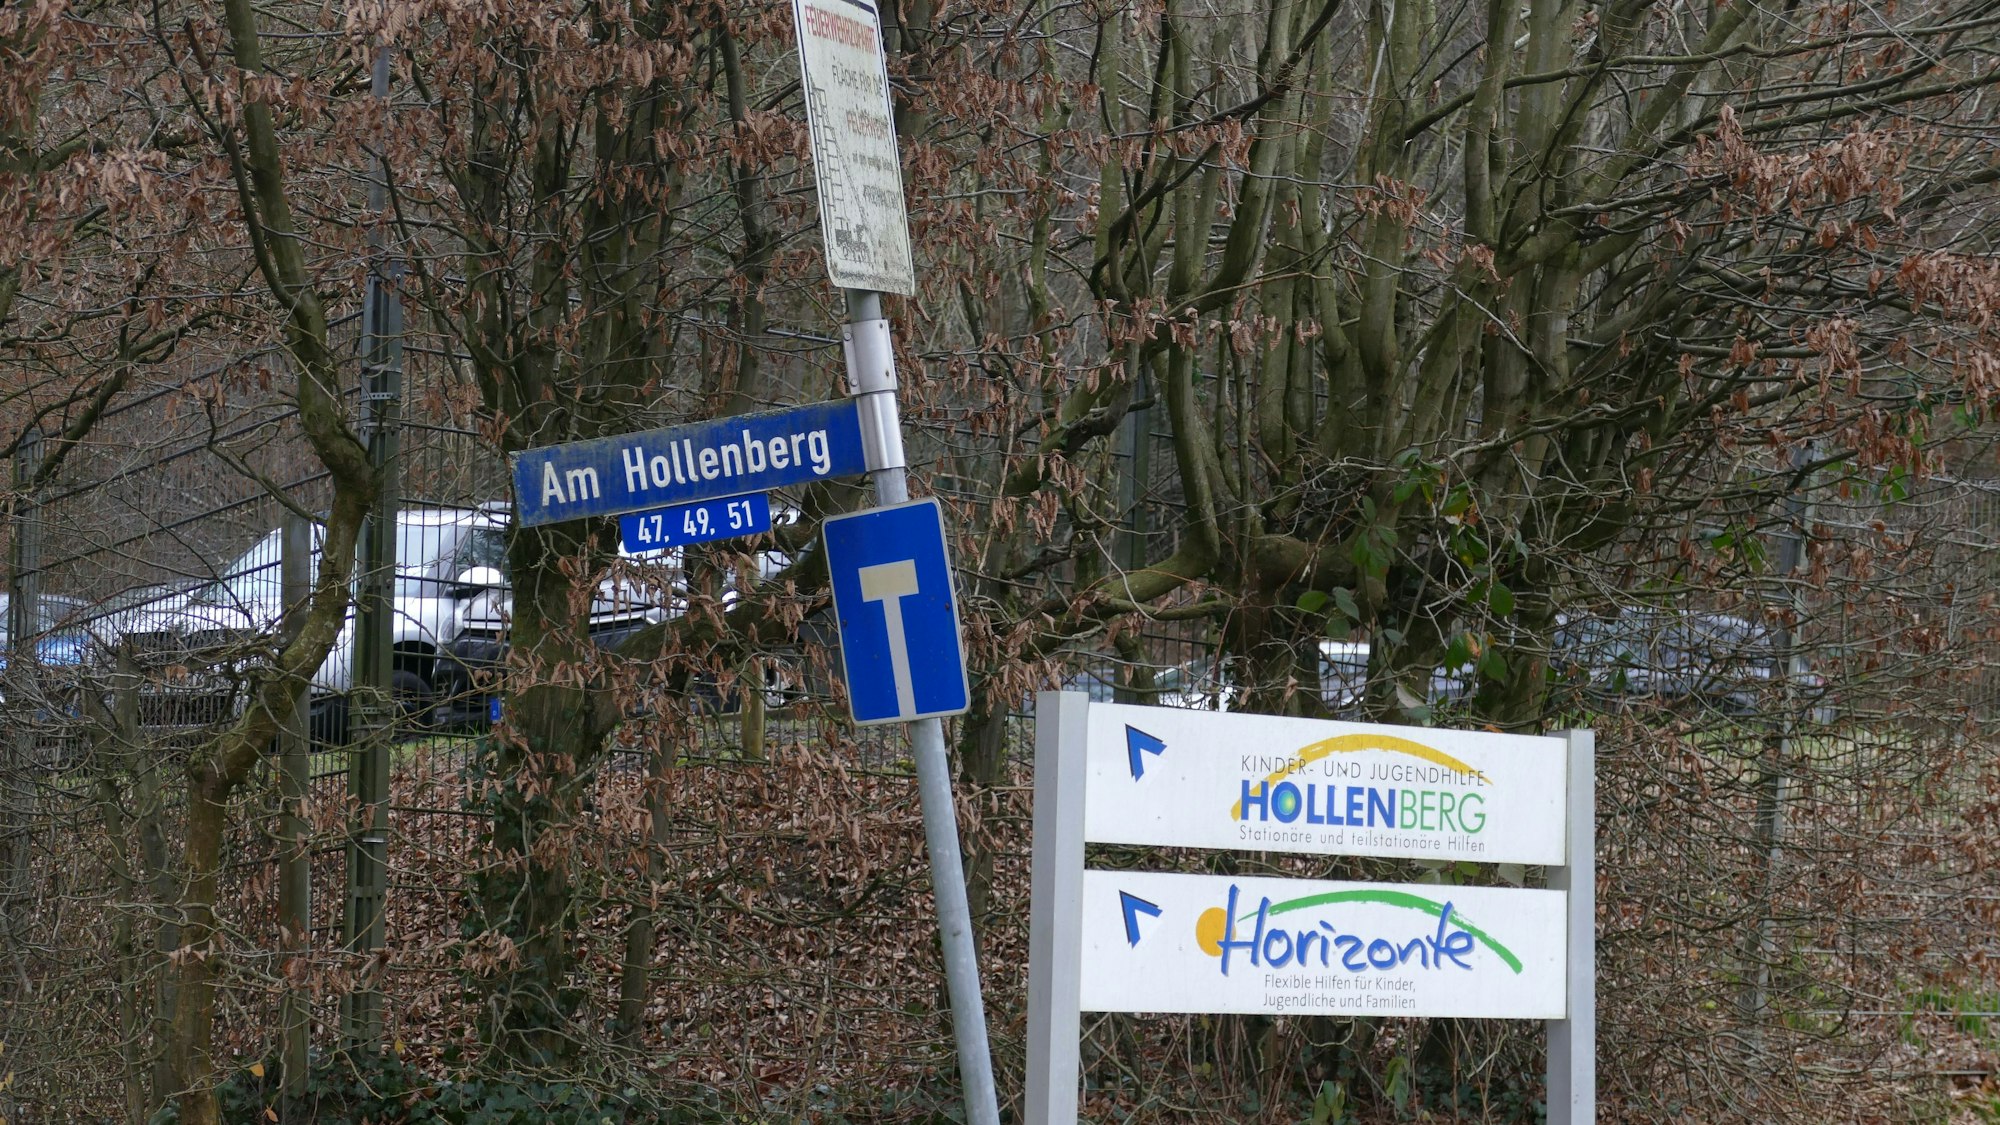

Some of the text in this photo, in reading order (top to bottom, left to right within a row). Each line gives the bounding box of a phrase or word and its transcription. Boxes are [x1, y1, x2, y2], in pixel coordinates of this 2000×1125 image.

[542, 429, 831, 506] Am Hollenberg
[638, 500, 754, 544] 47, 49, 51
[1241, 754, 1485, 787] KINDER- UND JUGENDHILFE
[1241, 779, 1487, 834] HOLLENBERG
[1239, 825, 1485, 852] Stationäre und teilstationäre Hilfen
[1217, 883, 1475, 976] Horizonte
[1263, 993, 1416, 1010] Jugendliche und Familien
[1264, 974, 1416, 993] Flexible Hilfen für Kinder,
